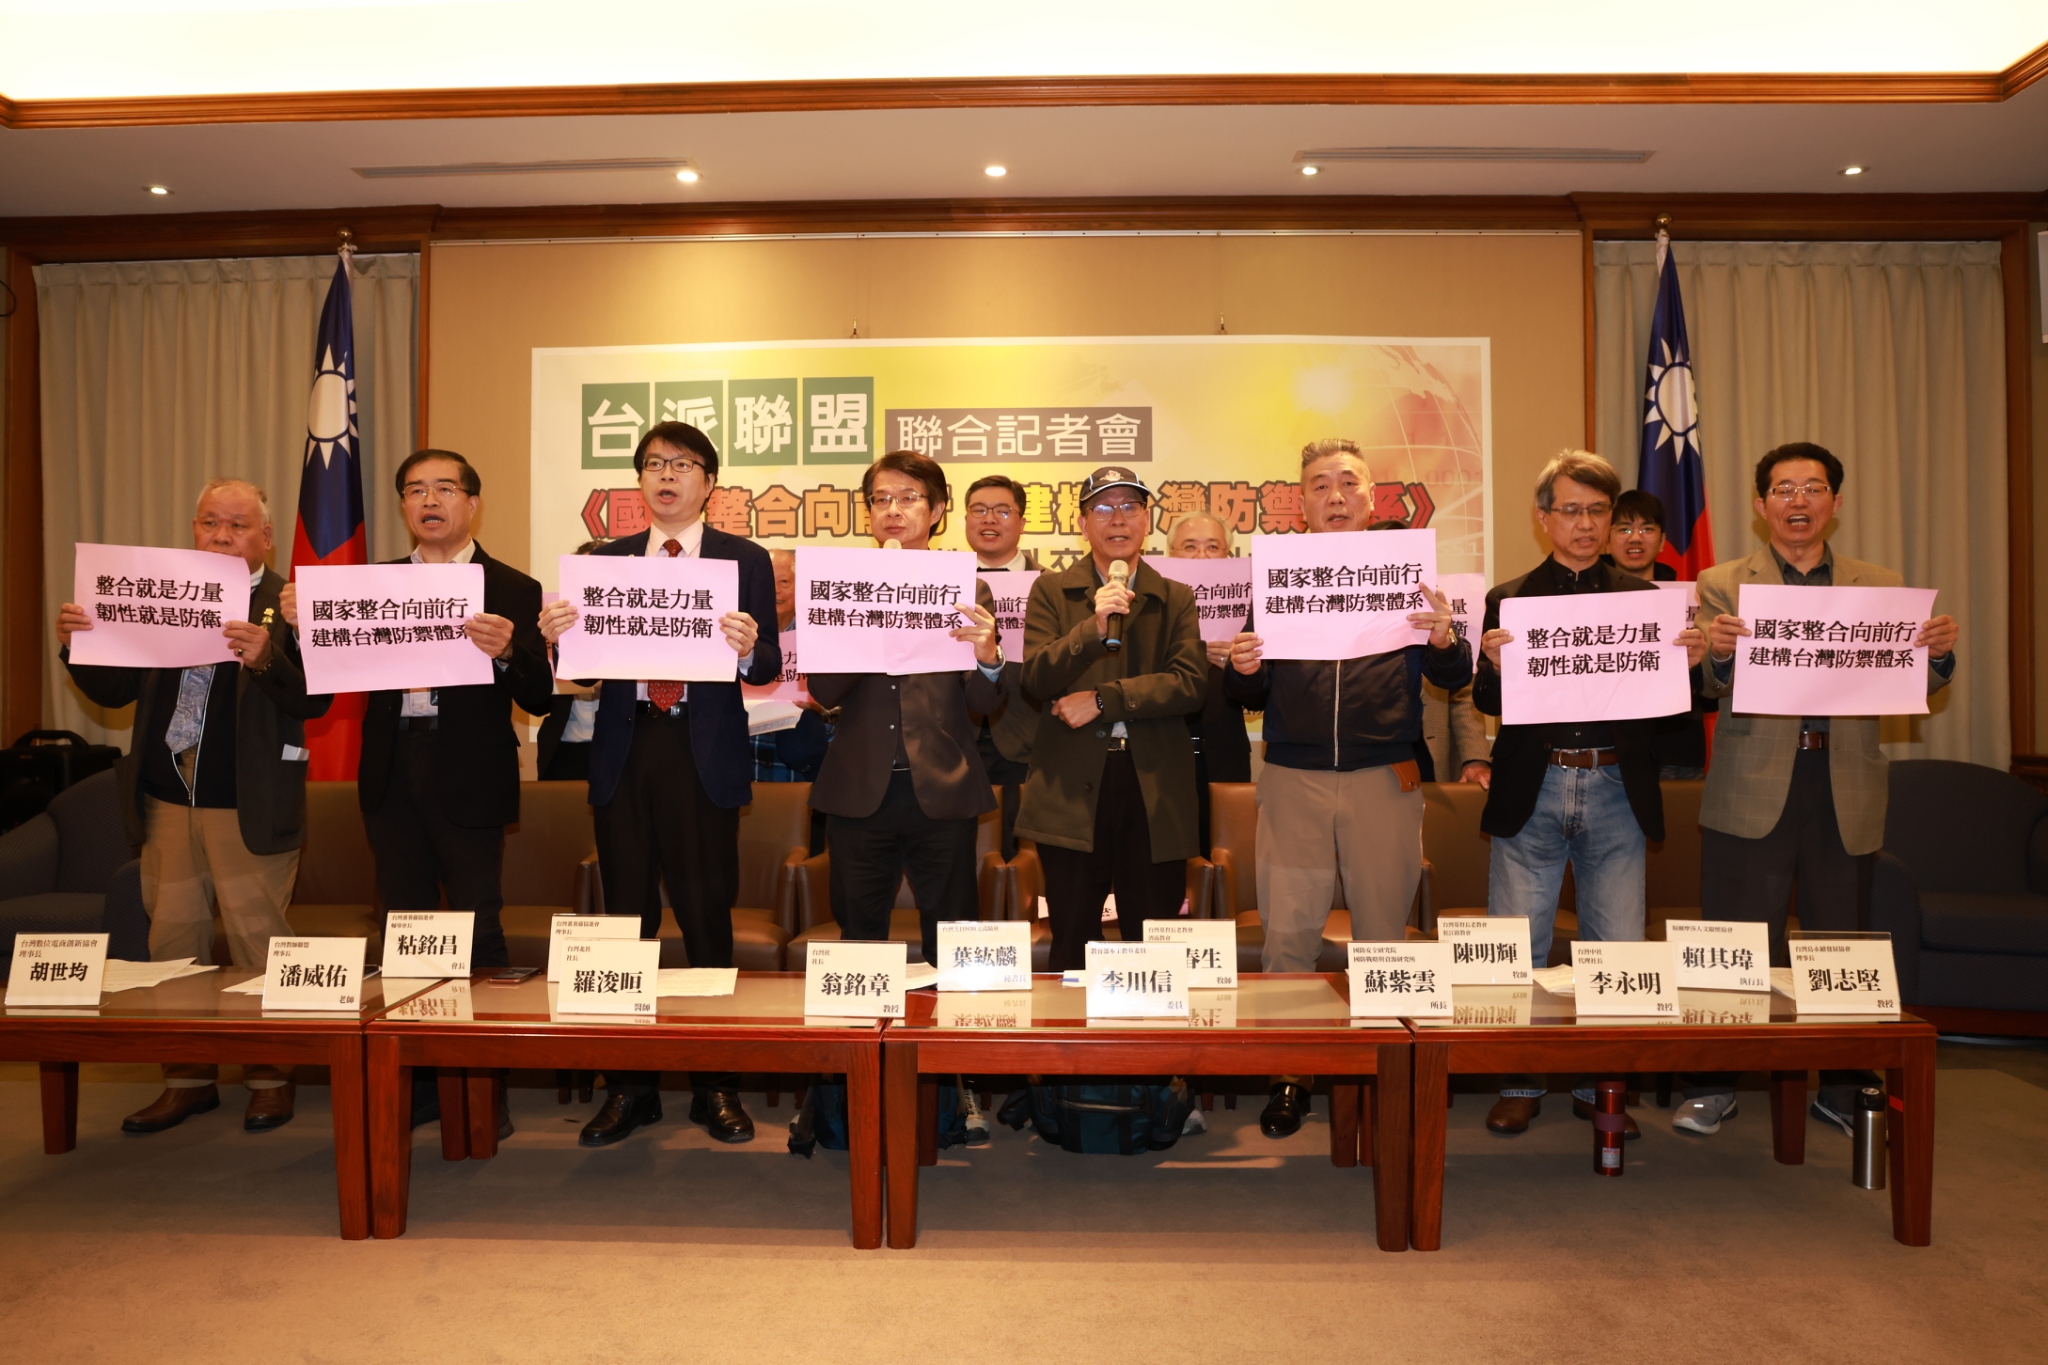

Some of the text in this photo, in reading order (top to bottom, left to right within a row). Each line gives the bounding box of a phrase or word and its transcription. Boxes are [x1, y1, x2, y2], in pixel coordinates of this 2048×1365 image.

[897, 413, 1142, 458] 聯合記者會
[1267, 562, 1423, 589] 國家整合向前行
[95, 574, 224, 603] 整合就是力量
[583, 586, 713, 610] 整合就是力量
[810, 580, 962, 606] 國家整合向前行
[312, 598, 468, 621] 國家整合向前行
[1265, 591, 1423, 615] 建構台灣防禦體系
[95, 602, 222, 629] 韌性就是防衛
[584, 614, 713, 638] 韌性就是防衛
[808, 607, 962, 630] 建構台灣防禦體系
[1527, 622, 1661, 650] 整合就是力量
[1754, 618, 1916, 643] 國家整合向前行
[1527, 650, 1661, 677] 韌性就是防衛
[1749, 647, 1914, 669] 建構台灣防禦體系
[19, 950, 42, 958] 理事長
[397, 934, 457, 955] 粘銘昌
[1353, 946, 1397, 954] 國防安全研究院
[1453, 942, 1518, 964] 陳明輝
[1578, 948, 1602, 956] 台灣中社
[451, 962, 465, 970] 會長
[952, 945, 1017, 968] 葉紘麟
[1682, 946, 1754, 971] 賴其瑋
[30, 962, 88, 982] 胡世均
[280, 964, 348, 988] 潘威佑
[1101, 970, 1172, 994] 李川信
[1217, 976, 1232, 985] 牧師
[1364, 969, 1435, 993] 蘇紫雲
[1512, 971, 1527, 979] 牧師
[1590, 971, 1661, 995] 李永明
[1740, 977, 1764, 986] 執行長
[1808, 968, 1882, 992] 劉志堅
[821, 972, 890, 996] 翁銘章
[340, 995, 354, 1004] 老師
[634, 1003, 650, 1012] 醫師
[883, 1004, 899, 1013] 教授
[1167, 1001, 1183, 1009] 委員
[1430, 1000, 1447, 1009] 所長
[1657, 1002, 1673, 1011] 教授
[1877, 999, 1894, 1008] 教授
